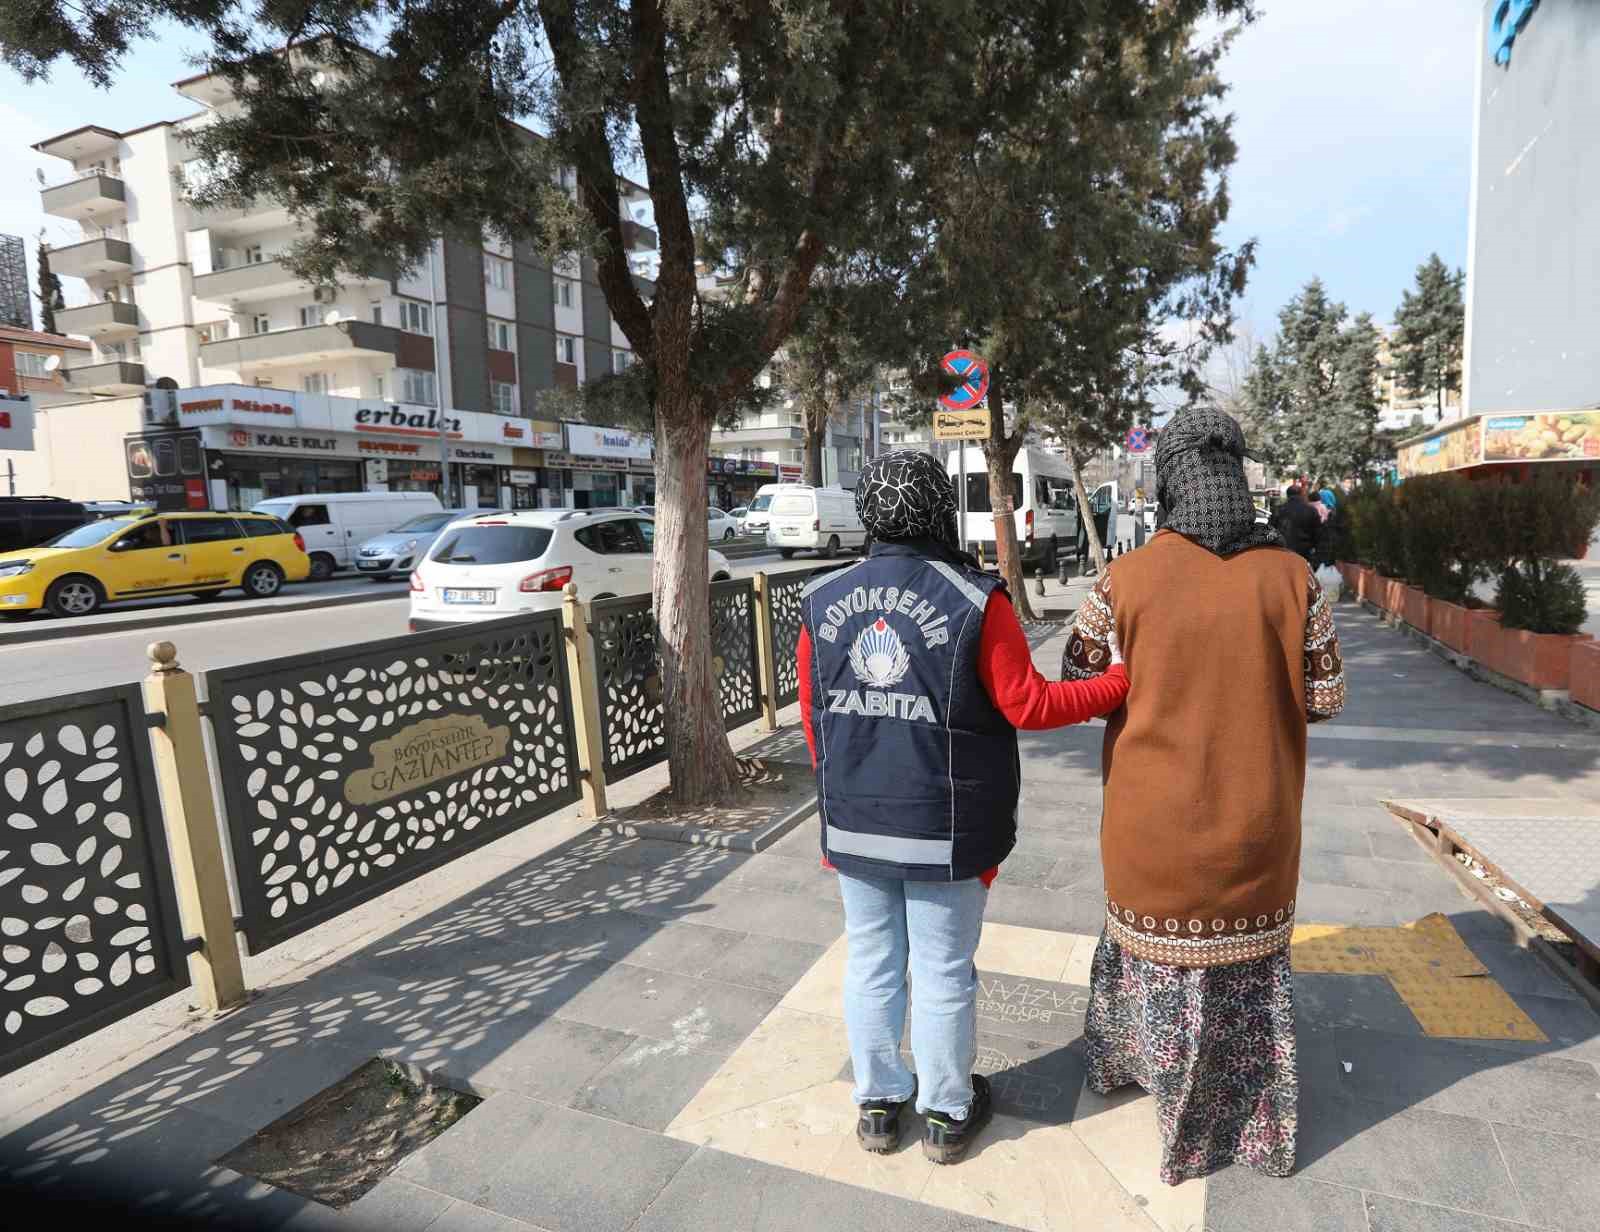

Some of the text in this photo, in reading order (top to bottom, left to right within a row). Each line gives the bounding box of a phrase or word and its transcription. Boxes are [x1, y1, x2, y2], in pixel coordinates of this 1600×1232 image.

[256, 433, 299, 448] KALE
[818, 585, 950, 650] BÜYÜKŞEHİR
[828, 690, 937, 723] ZABITA
